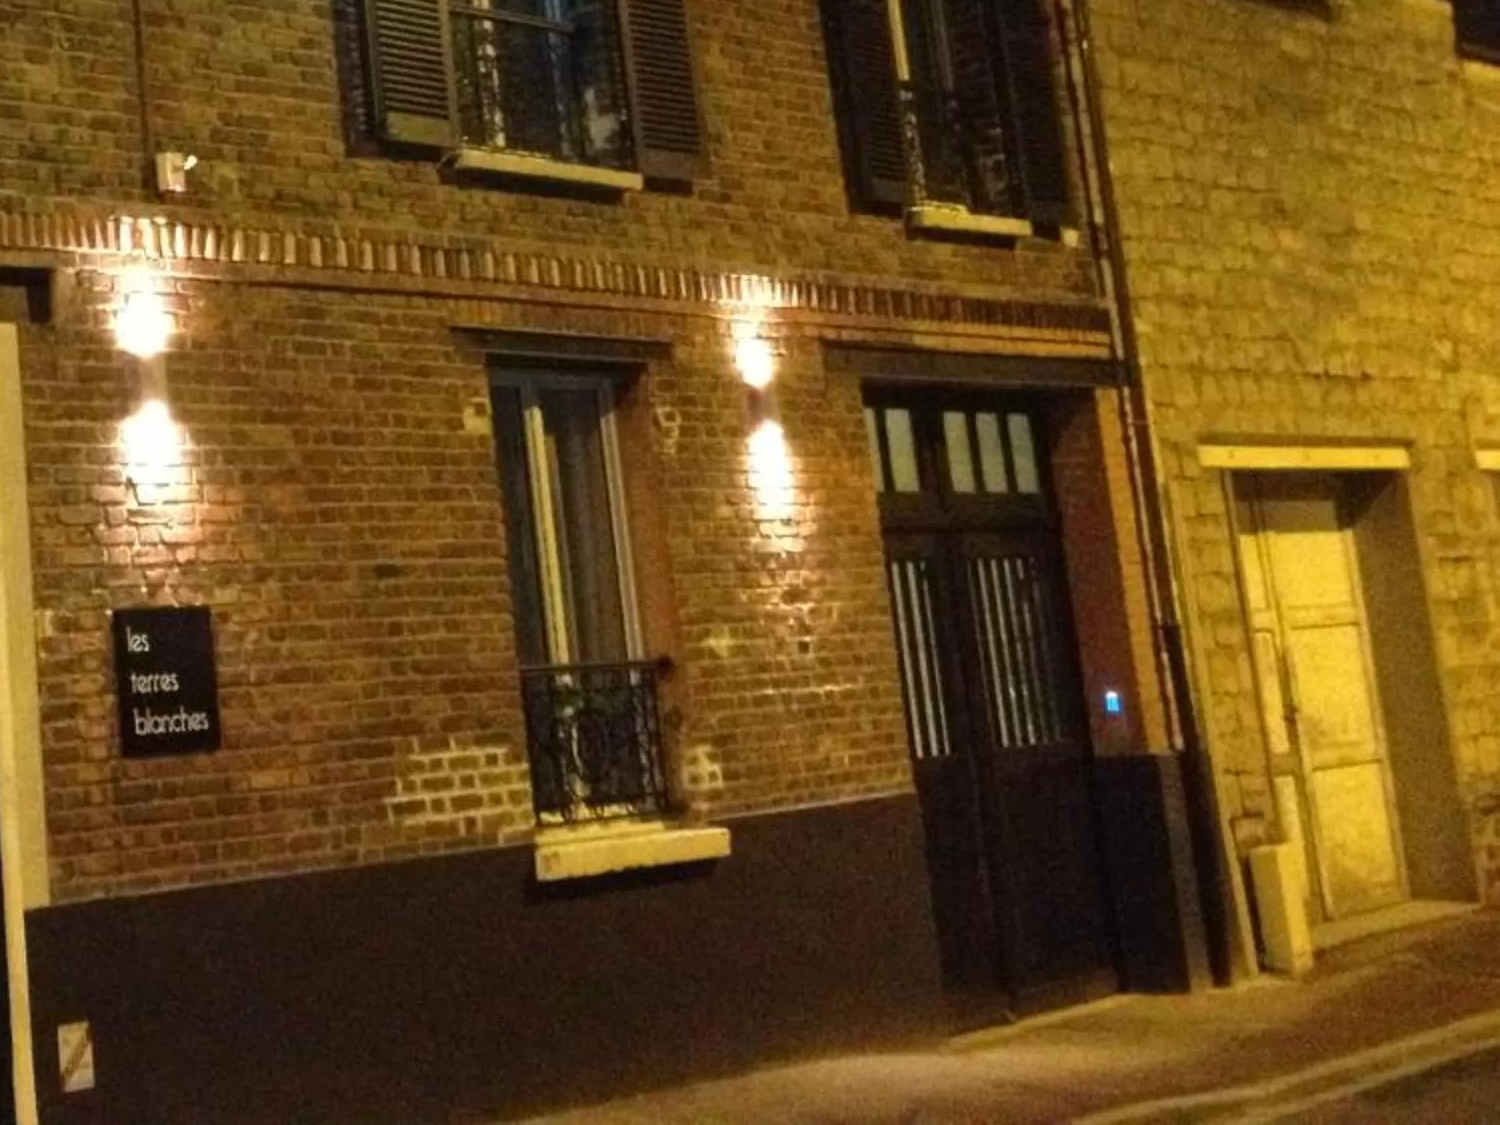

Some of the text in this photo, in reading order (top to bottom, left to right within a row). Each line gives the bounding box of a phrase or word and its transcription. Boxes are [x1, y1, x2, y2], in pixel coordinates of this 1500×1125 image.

[125, 626, 150, 653] les
[130, 672, 180, 694] terres
[133, 704, 209, 736] blanches
